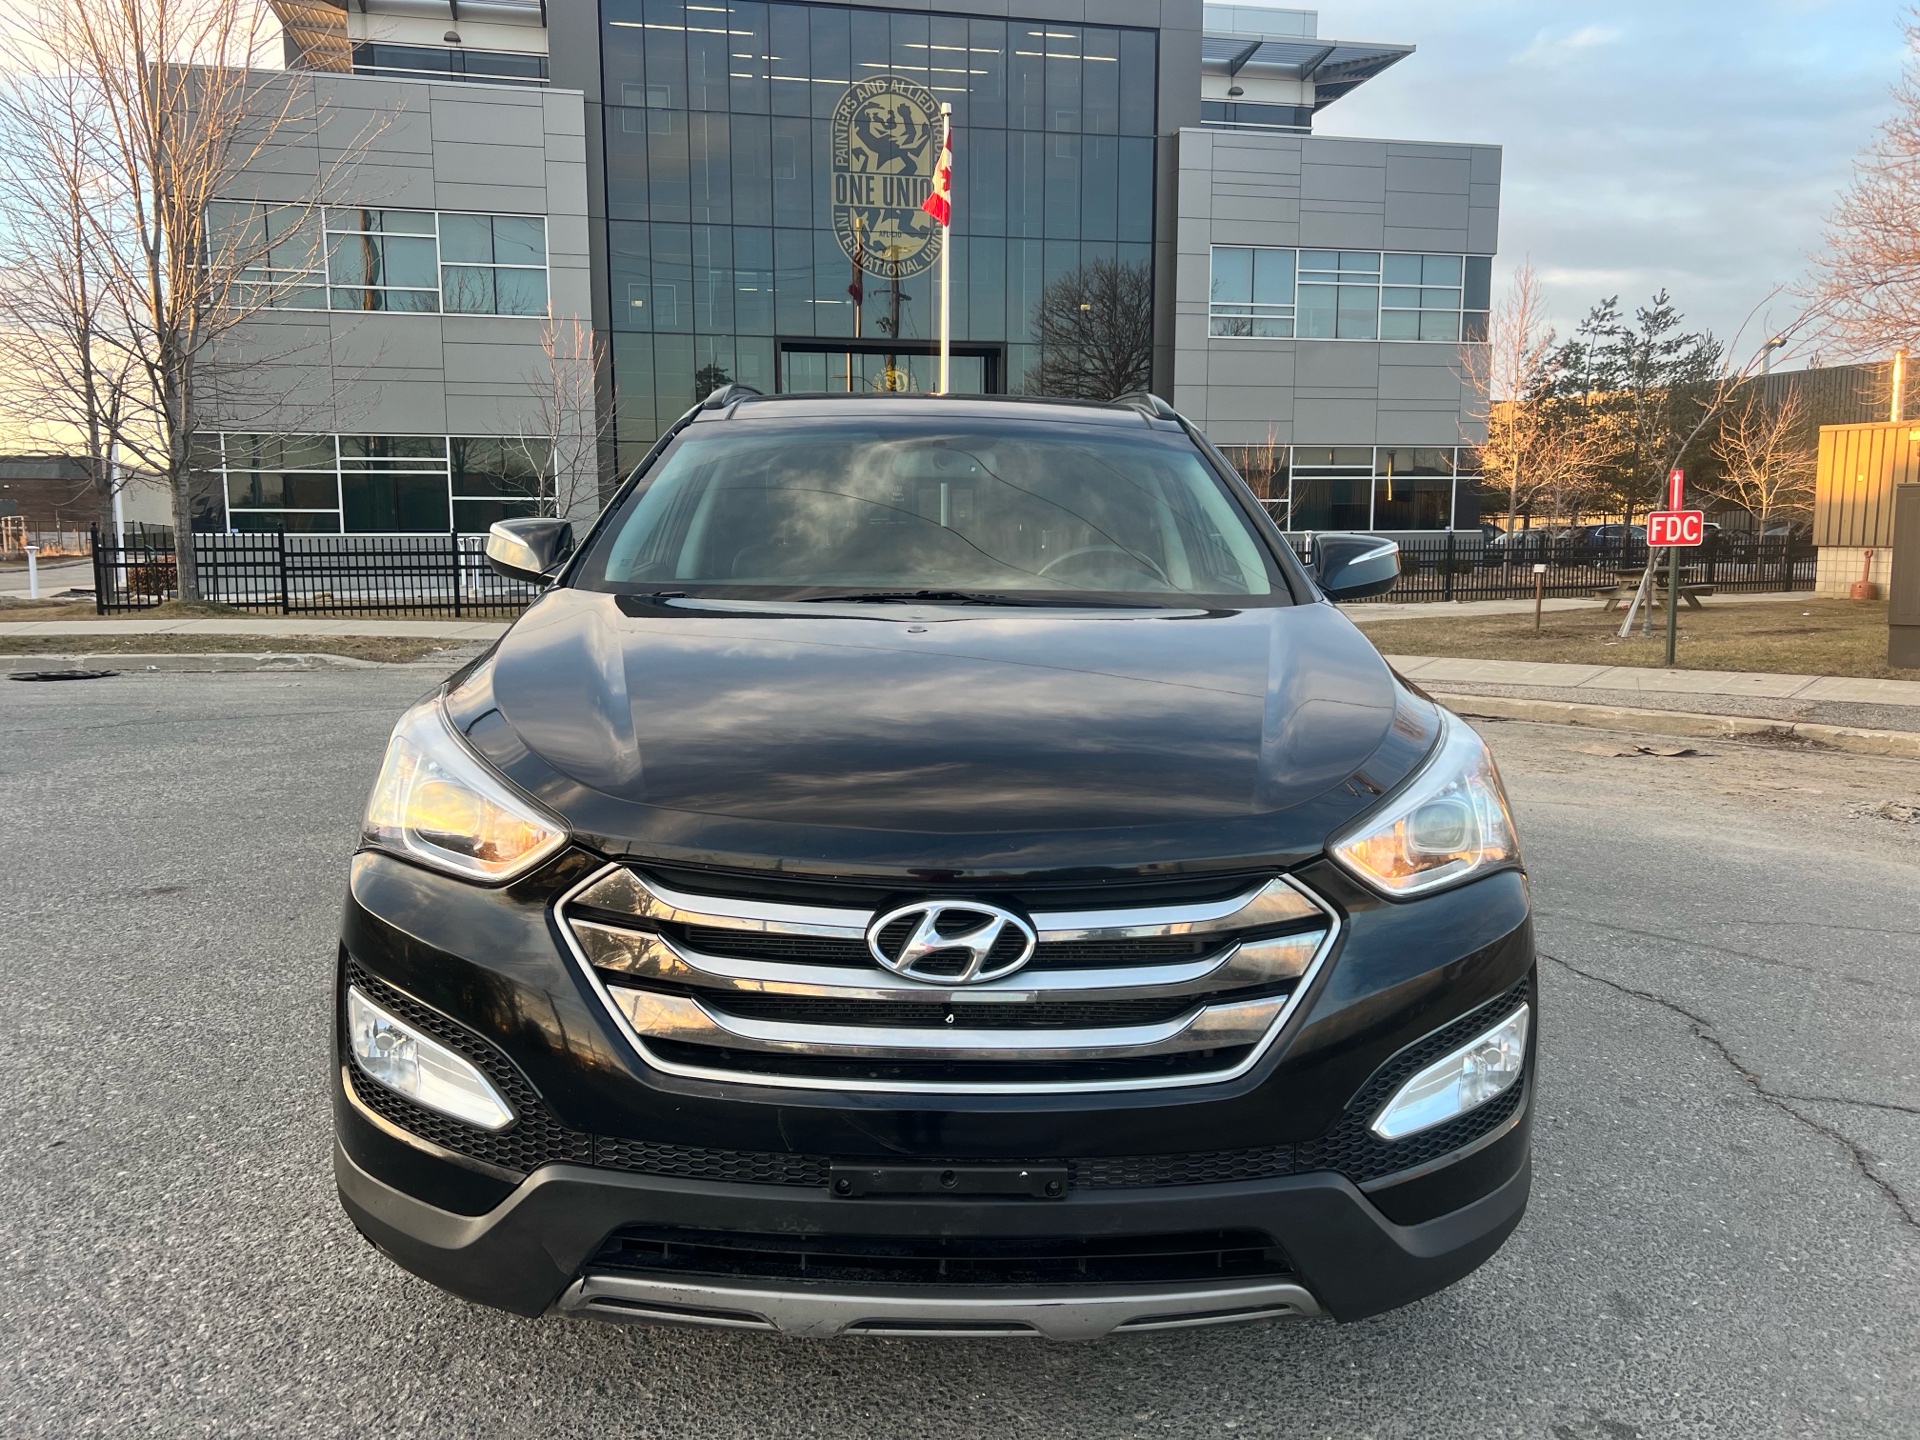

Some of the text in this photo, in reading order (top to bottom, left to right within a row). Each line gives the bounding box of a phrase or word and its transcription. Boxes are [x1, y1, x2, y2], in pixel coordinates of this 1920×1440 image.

[835, 80, 944, 167] PAINTERS AND ALLIED TRAD
[835, 173, 932, 208] ONE UNIO
[835, 212, 943, 276] INTERNATIONAL UNIO
[1651, 515, 1699, 542] FDC
